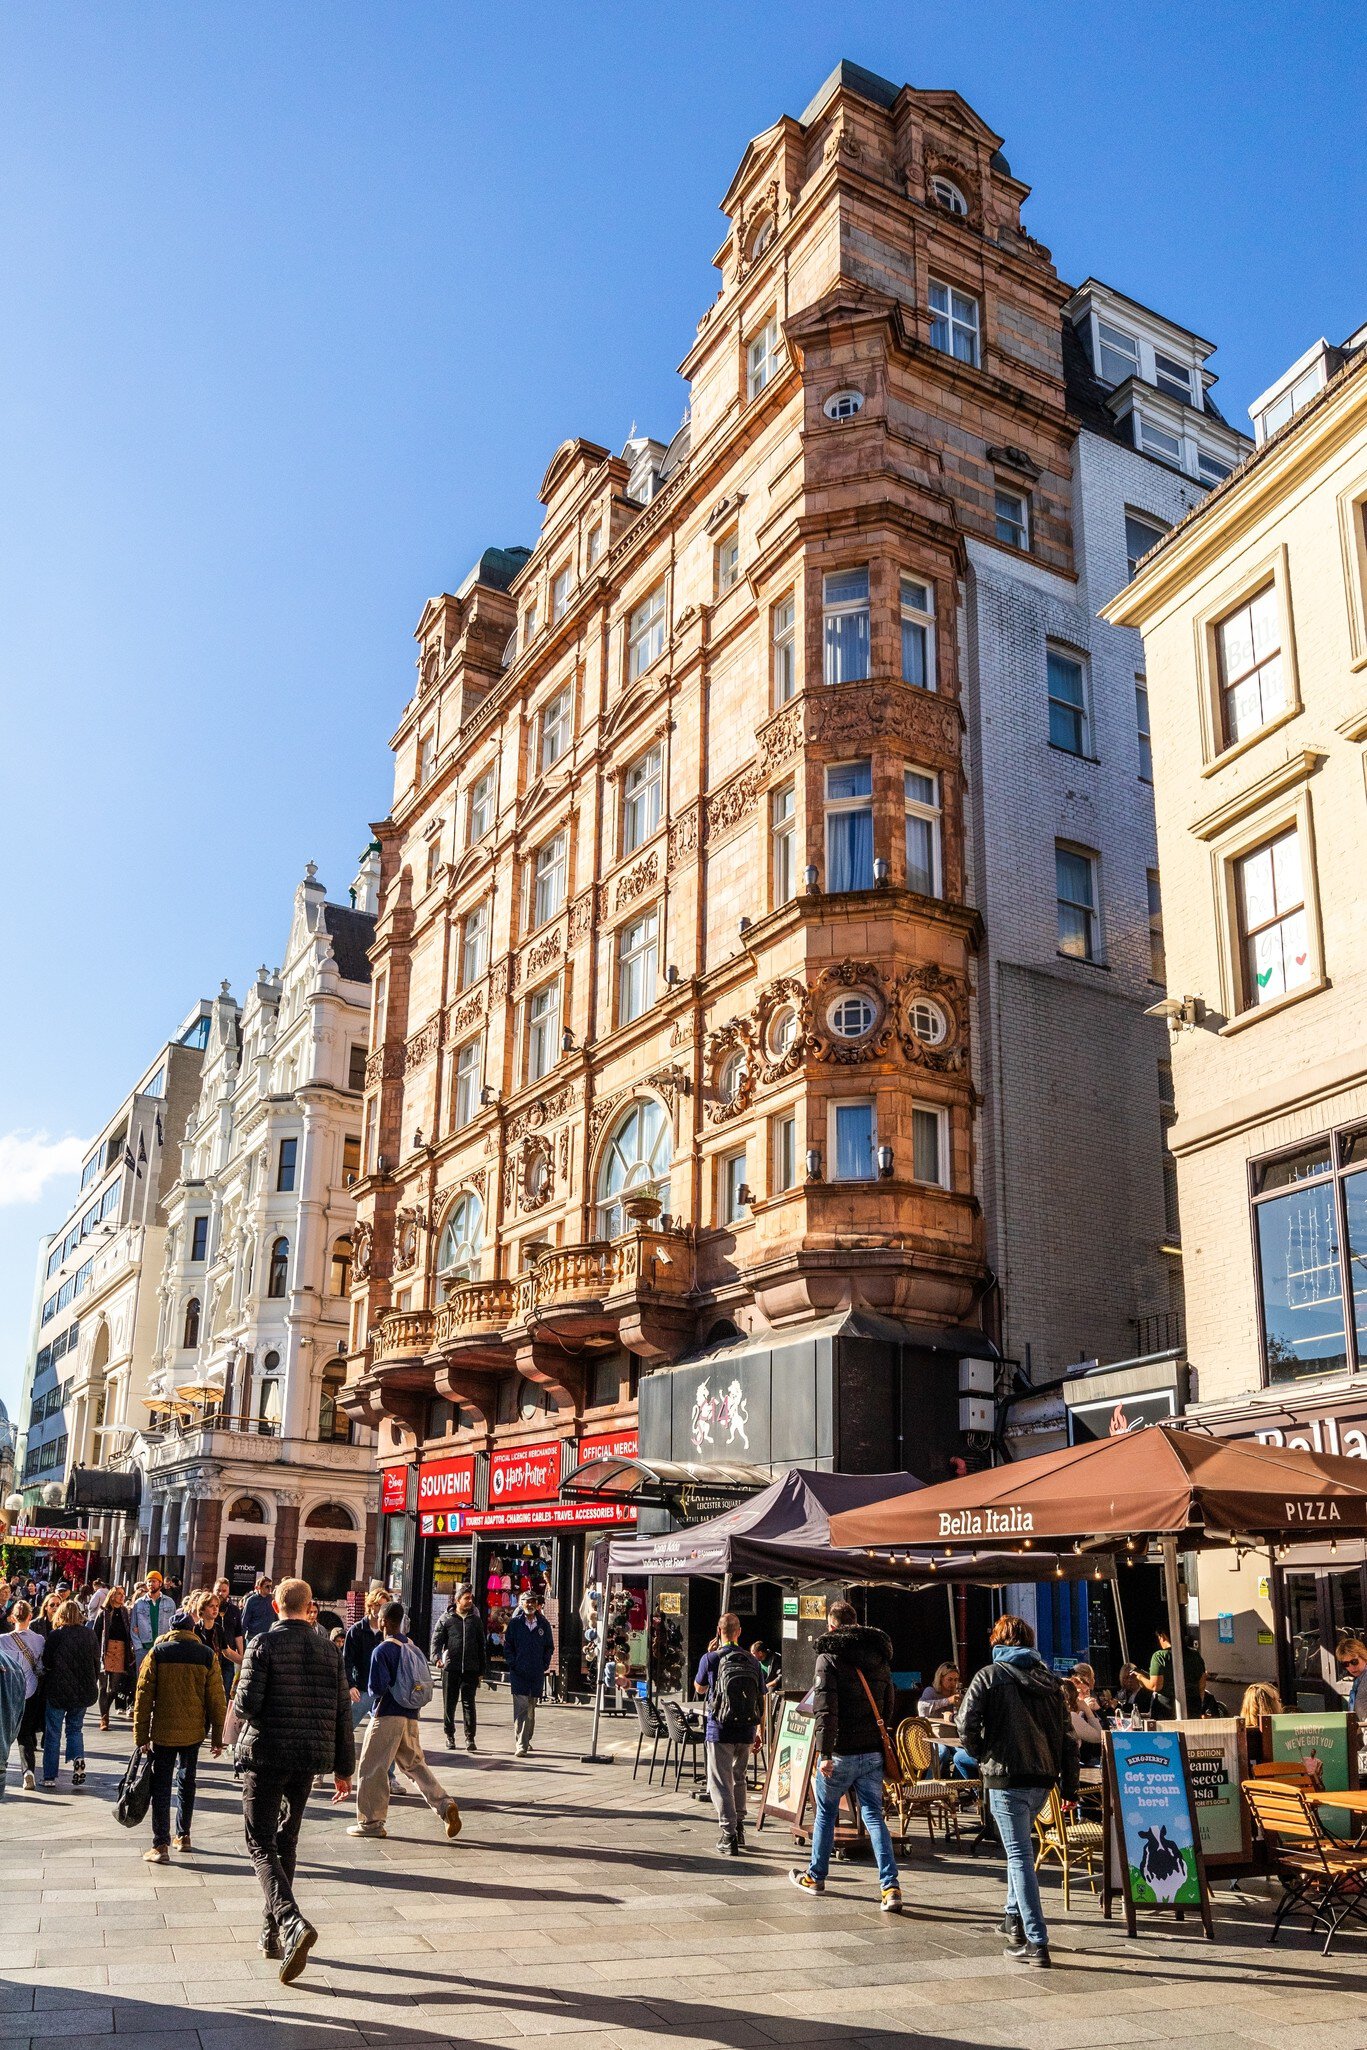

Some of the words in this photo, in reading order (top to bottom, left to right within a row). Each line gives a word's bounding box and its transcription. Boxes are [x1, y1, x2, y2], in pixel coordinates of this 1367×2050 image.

[493, 1453, 511, 1463] OFFICIAL
[528, 1446, 558, 1458] MERCHANDISE
[583, 1446, 612, 1459] OFFICIAL
[613, 1440, 638, 1454] MERCH
[420, 1471, 471, 1497] SOUVENIR
[505, 1465, 526, 1491] Harry
[524, 1462, 547, 1490] Potter
[696, 1502, 721, 1510] LEICESTER
[1285, 1502, 1341, 1521] PIZZA
[465, 1516, 484, 1527] TOURIST
[484, 1514, 505, 1525] ADAPTOR
[554, 1509, 574, 1521] TRAVEL
[575, 1506, 614, 1521] ACCESSORIES
[939, 1510, 982, 1536] Bella
[985, 1506, 1034, 1533] Italia
[15, 1525, 87, 1541] Horizons
[1306, 1736, 1319, 1746] GOT
[1320, 1737, 1334, 1749] YOU
[1188, 1759, 1220, 1773] eamy
[1124, 1771, 1146, 1782] Get
[1146, 1772, 1176, 1785] your
[1124, 1783, 1141, 1795] ice
[1142, 1785, 1181, 1795] cream
[1138, 1796, 1170, 1807] here!
